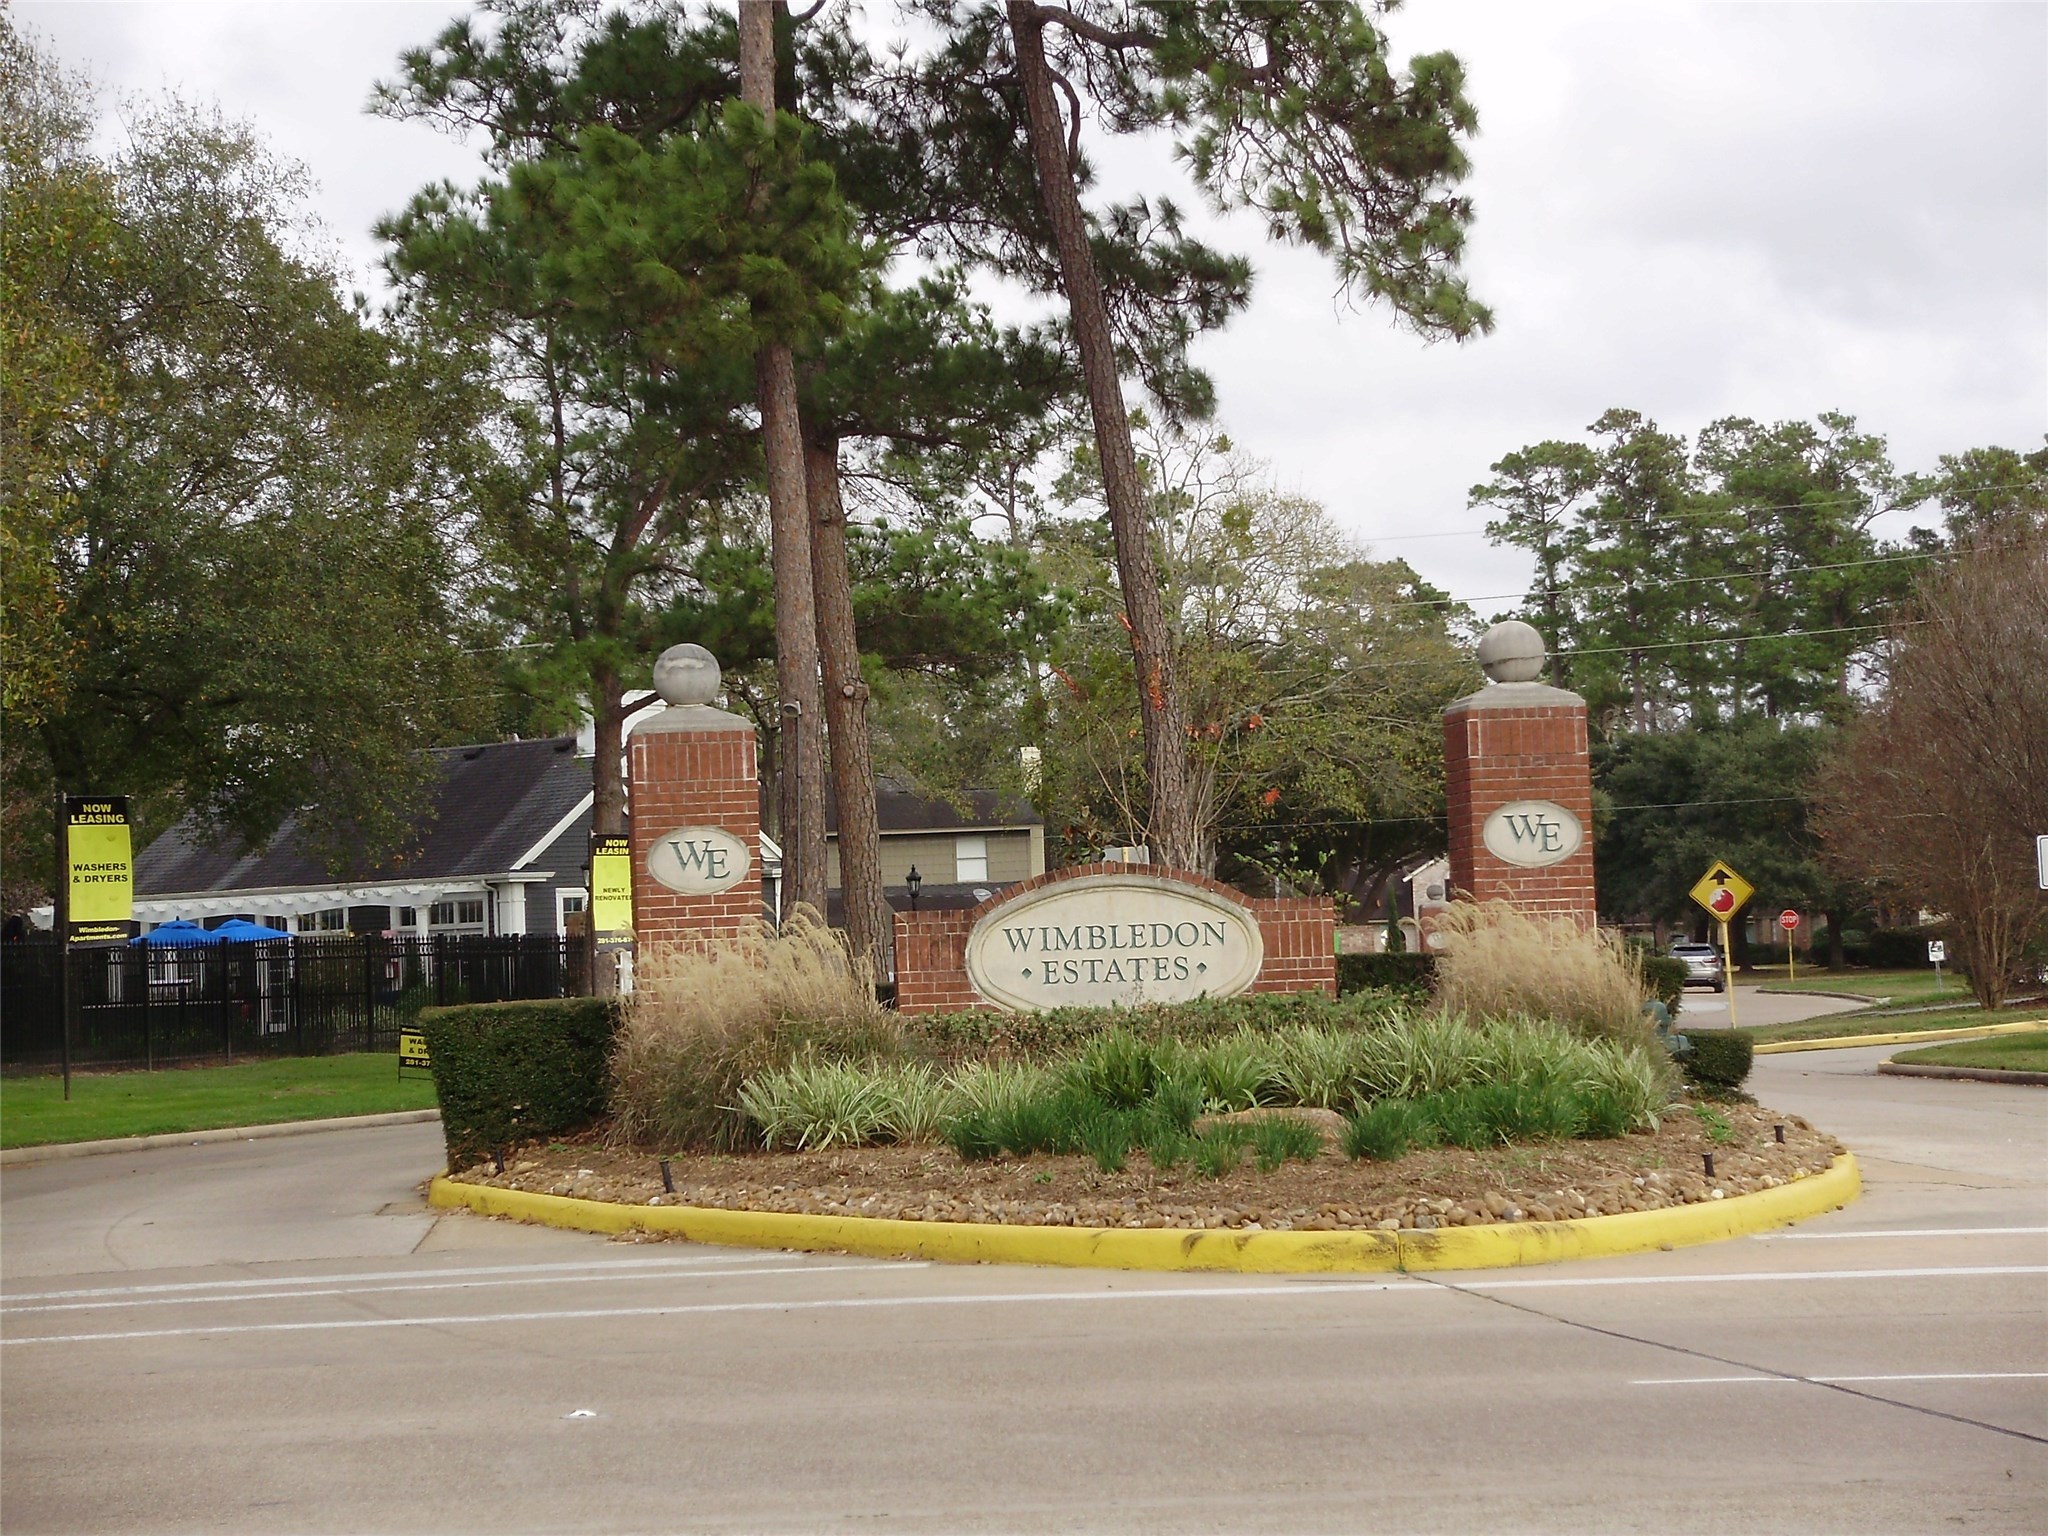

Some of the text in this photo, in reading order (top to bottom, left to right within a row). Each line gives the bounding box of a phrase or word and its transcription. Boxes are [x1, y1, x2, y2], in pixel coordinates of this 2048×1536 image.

[83, 804, 111, 813] NOW
[71, 814, 125, 824] LEASING
[1502, 813, 1563, 852] WE
[606, 839, 628, 847] NOW
[596, 847, 629, 855] LEASIN
[668, 840, 730, 879] WE
[73, 863, 127, 871] WASHERS
[84, 875, 128, 883] DRYERS
[1781, 915, 1797, 924] STOP
[69, 933, 128, 943] Apartments.com
[1002, 921, 1227, 952] WIMBLEDON
[1042, 956, 1190, 985] ESTATES
[405, 1058, 430, 1067] 281-37
